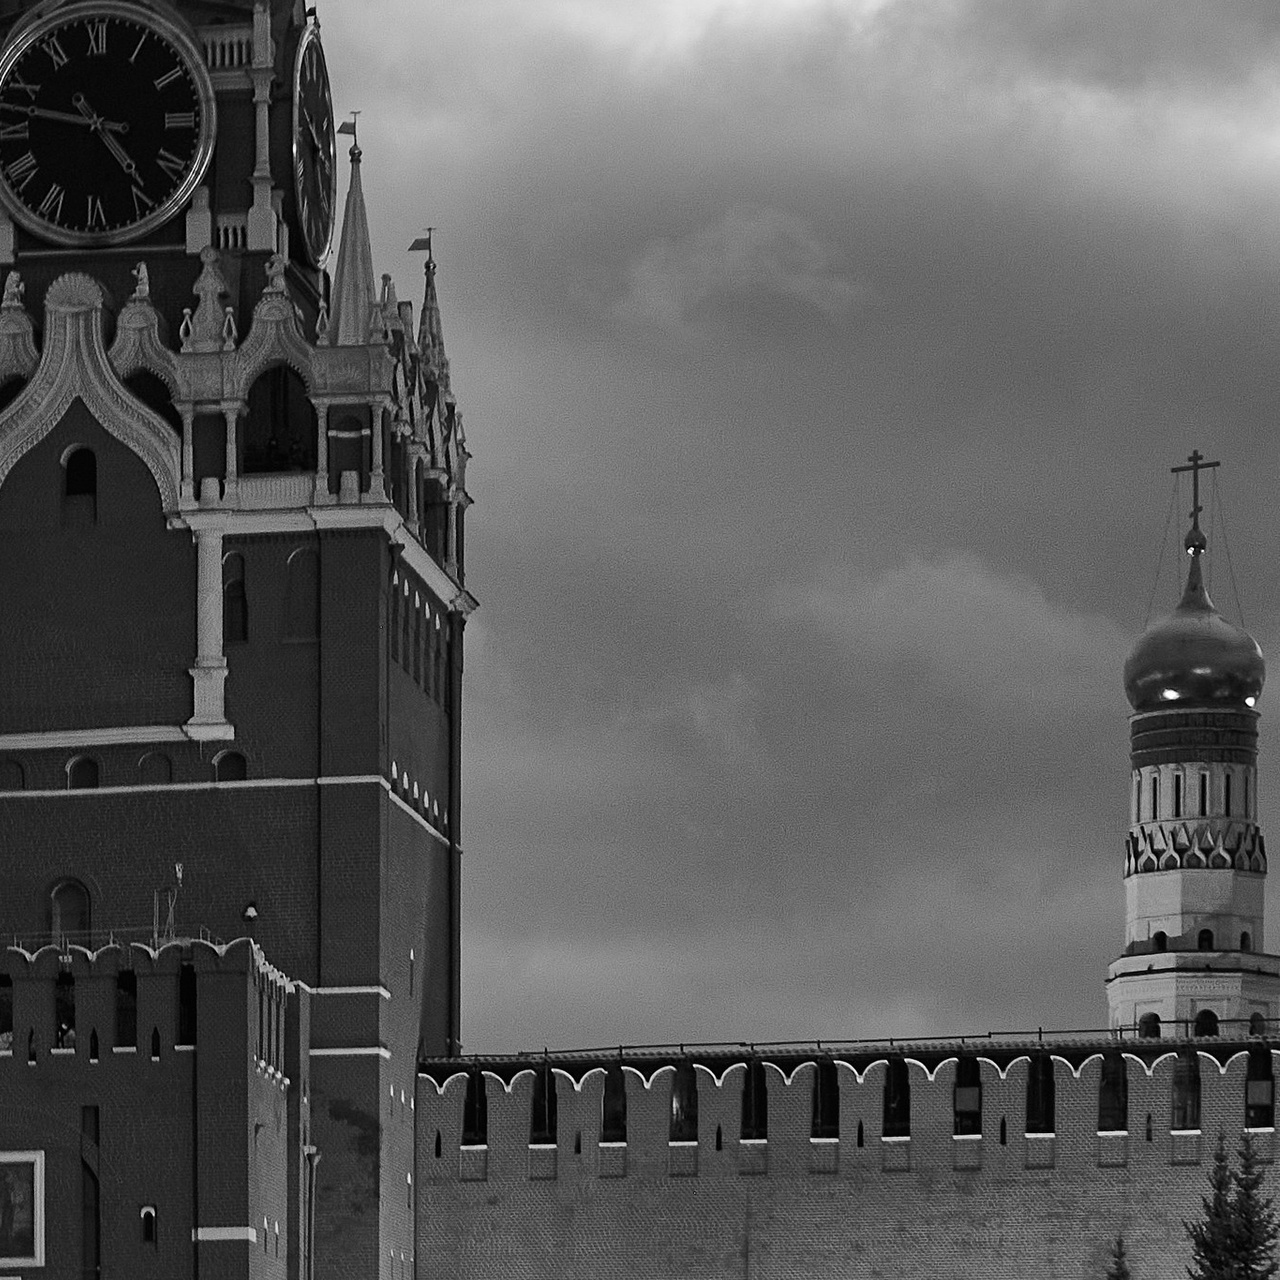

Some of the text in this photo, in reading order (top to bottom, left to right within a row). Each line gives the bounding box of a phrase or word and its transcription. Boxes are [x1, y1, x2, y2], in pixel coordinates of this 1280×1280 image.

[86, 21, 108, 56] XII
[129, 29, 150, 64] I
[10, 70, 41, 101] X
[153, 66, 183, 91] II
[165, 112, 195, 129] III
[131, 184, 155, 221] V
